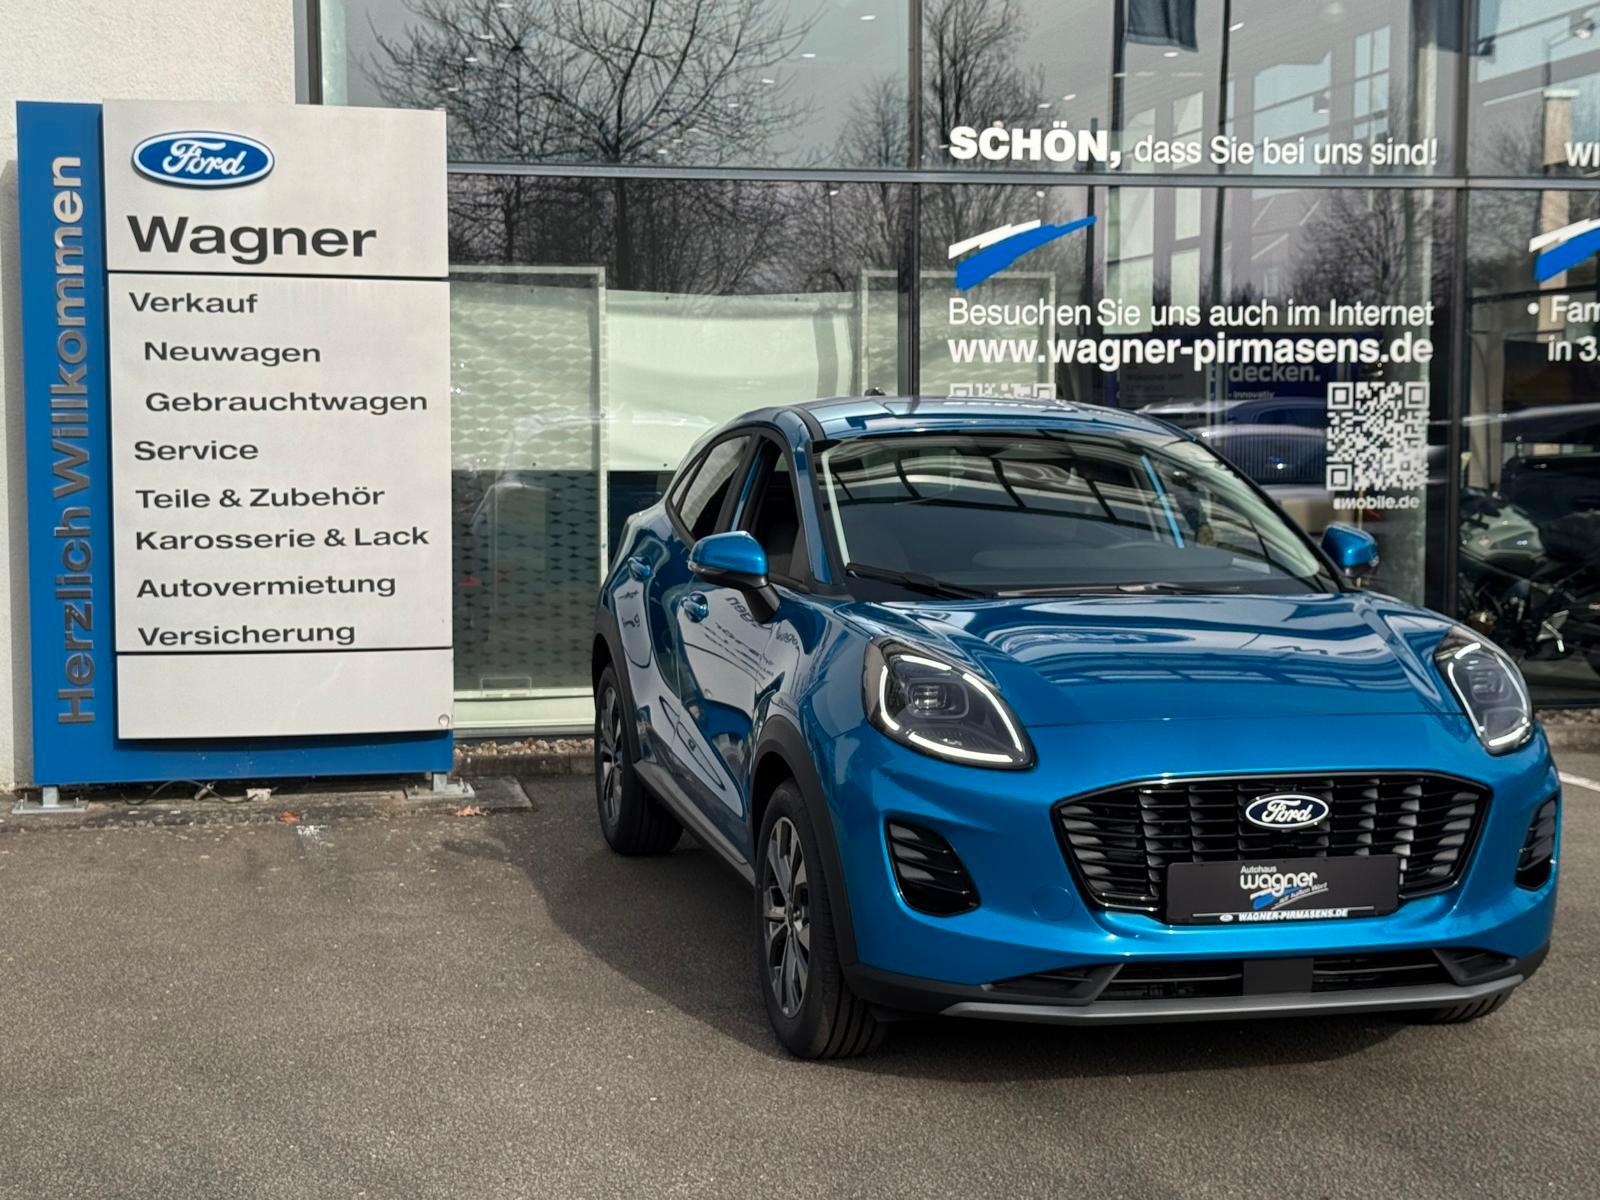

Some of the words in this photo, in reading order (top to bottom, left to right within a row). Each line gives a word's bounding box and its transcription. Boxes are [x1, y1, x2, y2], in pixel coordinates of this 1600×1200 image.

[949, 122, 1121, 168] SCHÖN,
[1134, 135, 1202, 165] dass
[1209, 134, 1255, 166] Sie
[1263, 136, 1306, 166] bei
[1313, 141, 1362, 166] uns
[1370, 136, 1438, 167] sind!
[127, 215, 377, 265] Wagner
[128, 292, 259, 314] Verkauf
[948, 298, 1092, 328] Besuchen
[1097, 299, 1141, 328] Sie
[1150, 304, 1201, 327] uns
[1208, 300, 1279, 328] auch
[1288, 299, 1319, 327] im
[1328, 301, 1435, 327] Internet
[50, 156, 91, 499] Willkommen
[144, 342, 322, 367] Neuwagen
[948, 333, 1435, 372] www.wagner-pirmasens.de
[1548, 335, 1572, 362] in
[145, 392, 429, 415] Gebrauchtwagen
[134, 441, 260, 461] Service
[136, 490, 211, 509] Teile
[219, 489, 242, 509] &
[249, 487, 386, 508] Zubehör
[136, 529, 316, 551] Karosserie
[324, 529, 347, 547] &
[354, 527, 431, 547] Lack
[136, 576, 397, 599] Autovermietung
[53, 506, 95, 724] Herzlich
[138, 624, 356, 647] Versicherung
[1240, 865, 1277, 874] Autohaus
[1240, 872, 1317, 895] wagner
[1238, 909, 1348, 922] WAGNER-PIRMASENS.DE
